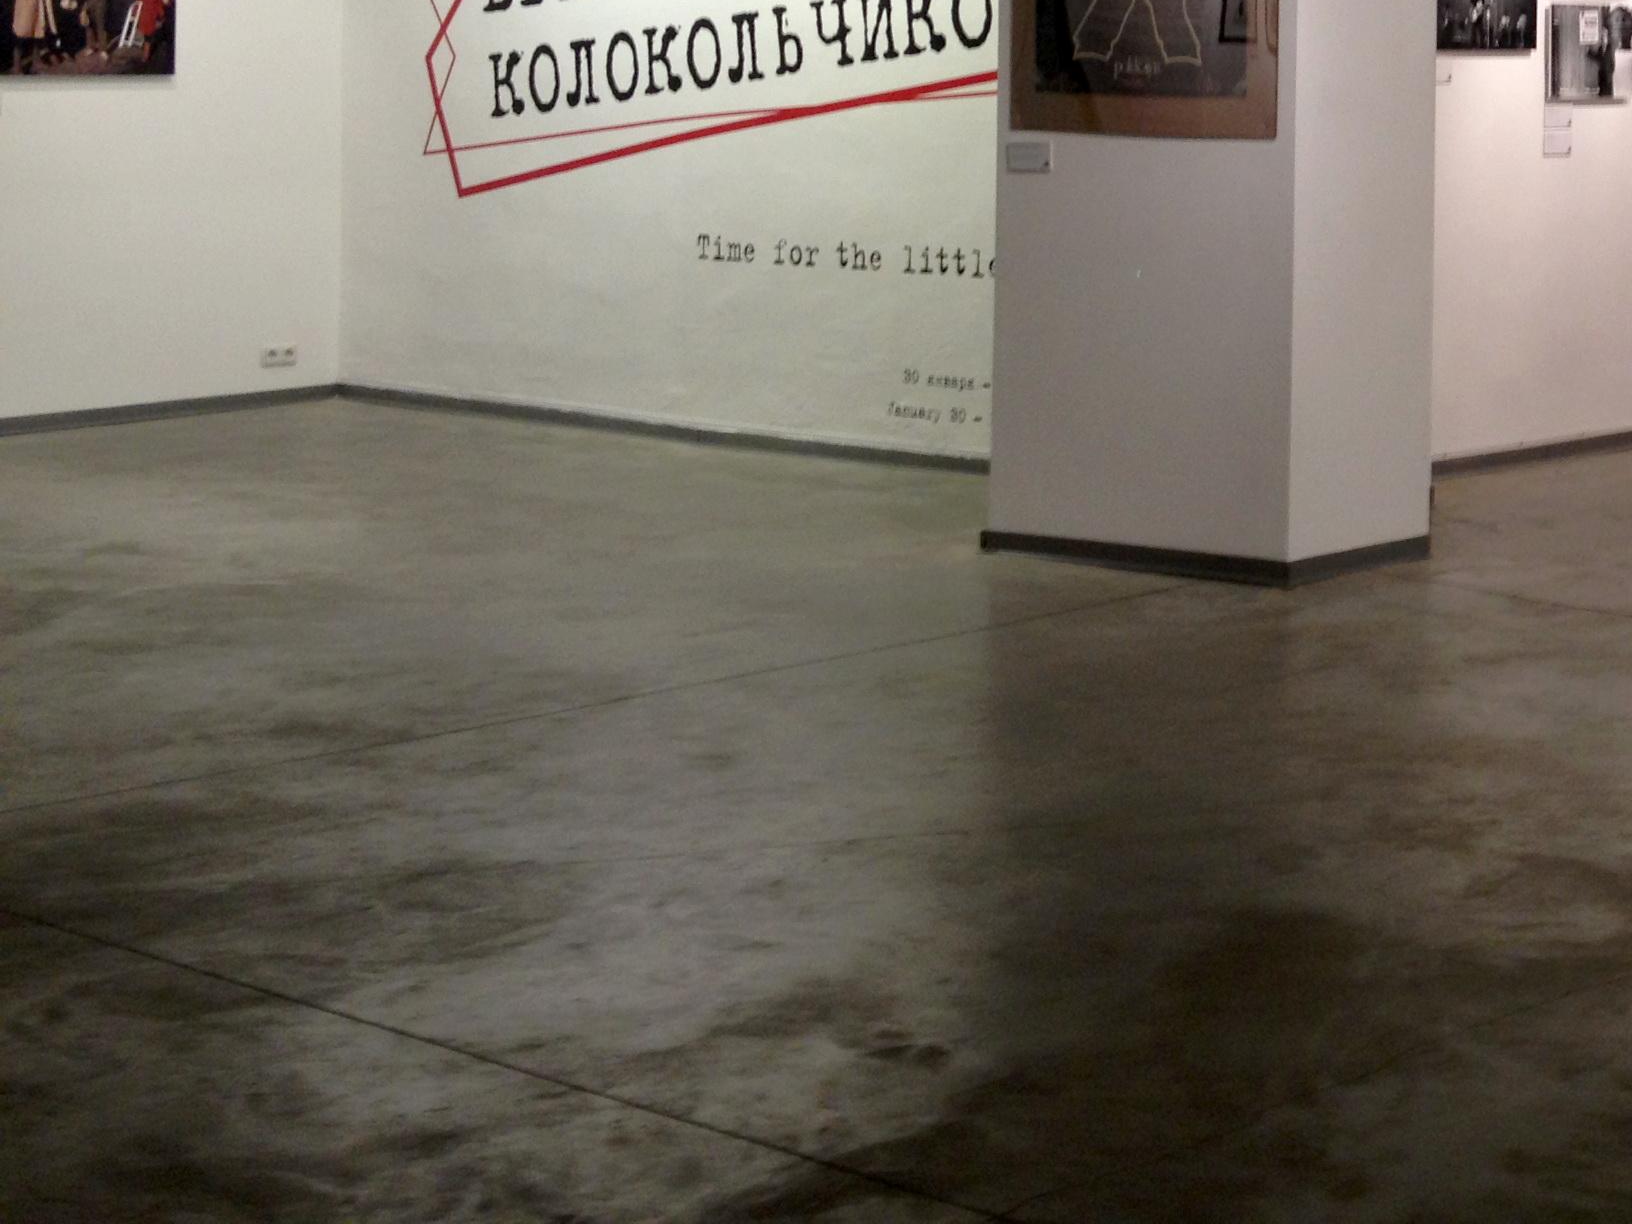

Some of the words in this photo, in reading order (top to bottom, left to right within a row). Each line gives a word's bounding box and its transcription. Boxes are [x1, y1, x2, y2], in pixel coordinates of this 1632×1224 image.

[697, 233, 756, 263] Time
[773, 238, 820, 269] for
[836, 240, 882, 271] the
[902, 367, 920, 385] 30
[887, 400, 942, 425] January
[950, 406, 967, 424] 30
